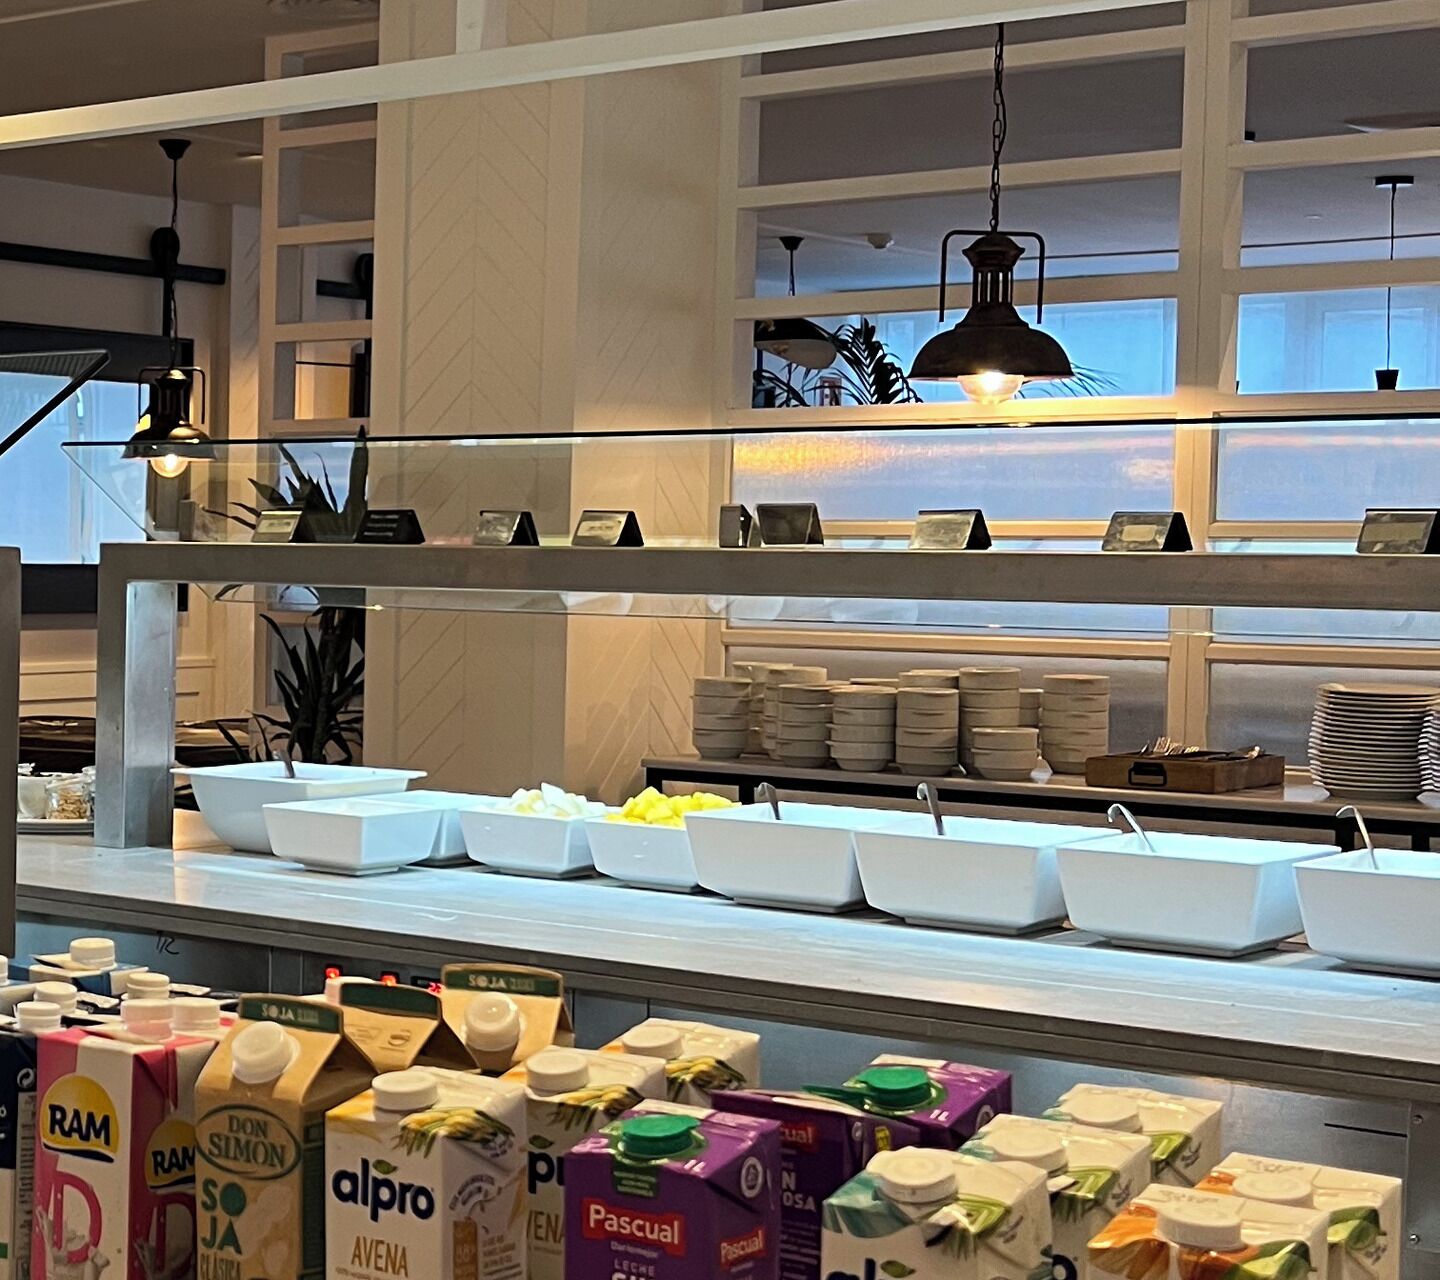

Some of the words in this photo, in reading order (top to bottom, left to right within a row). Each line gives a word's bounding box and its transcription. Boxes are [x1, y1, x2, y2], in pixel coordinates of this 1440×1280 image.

[49, 1103, 111, 1147] RAM
[228, 1115, 268, 1138] DON
[208, 1132, 287, 1169] SIMON
[332, 1157, 435, 1223] alpro
[589, 1204, 679, 1245] Pascual
[351, 1235, 409, 1278] AVENA
[720, 1229, 764, 1263] Pascual
[614, 1258, 655, 1278] LECHE
